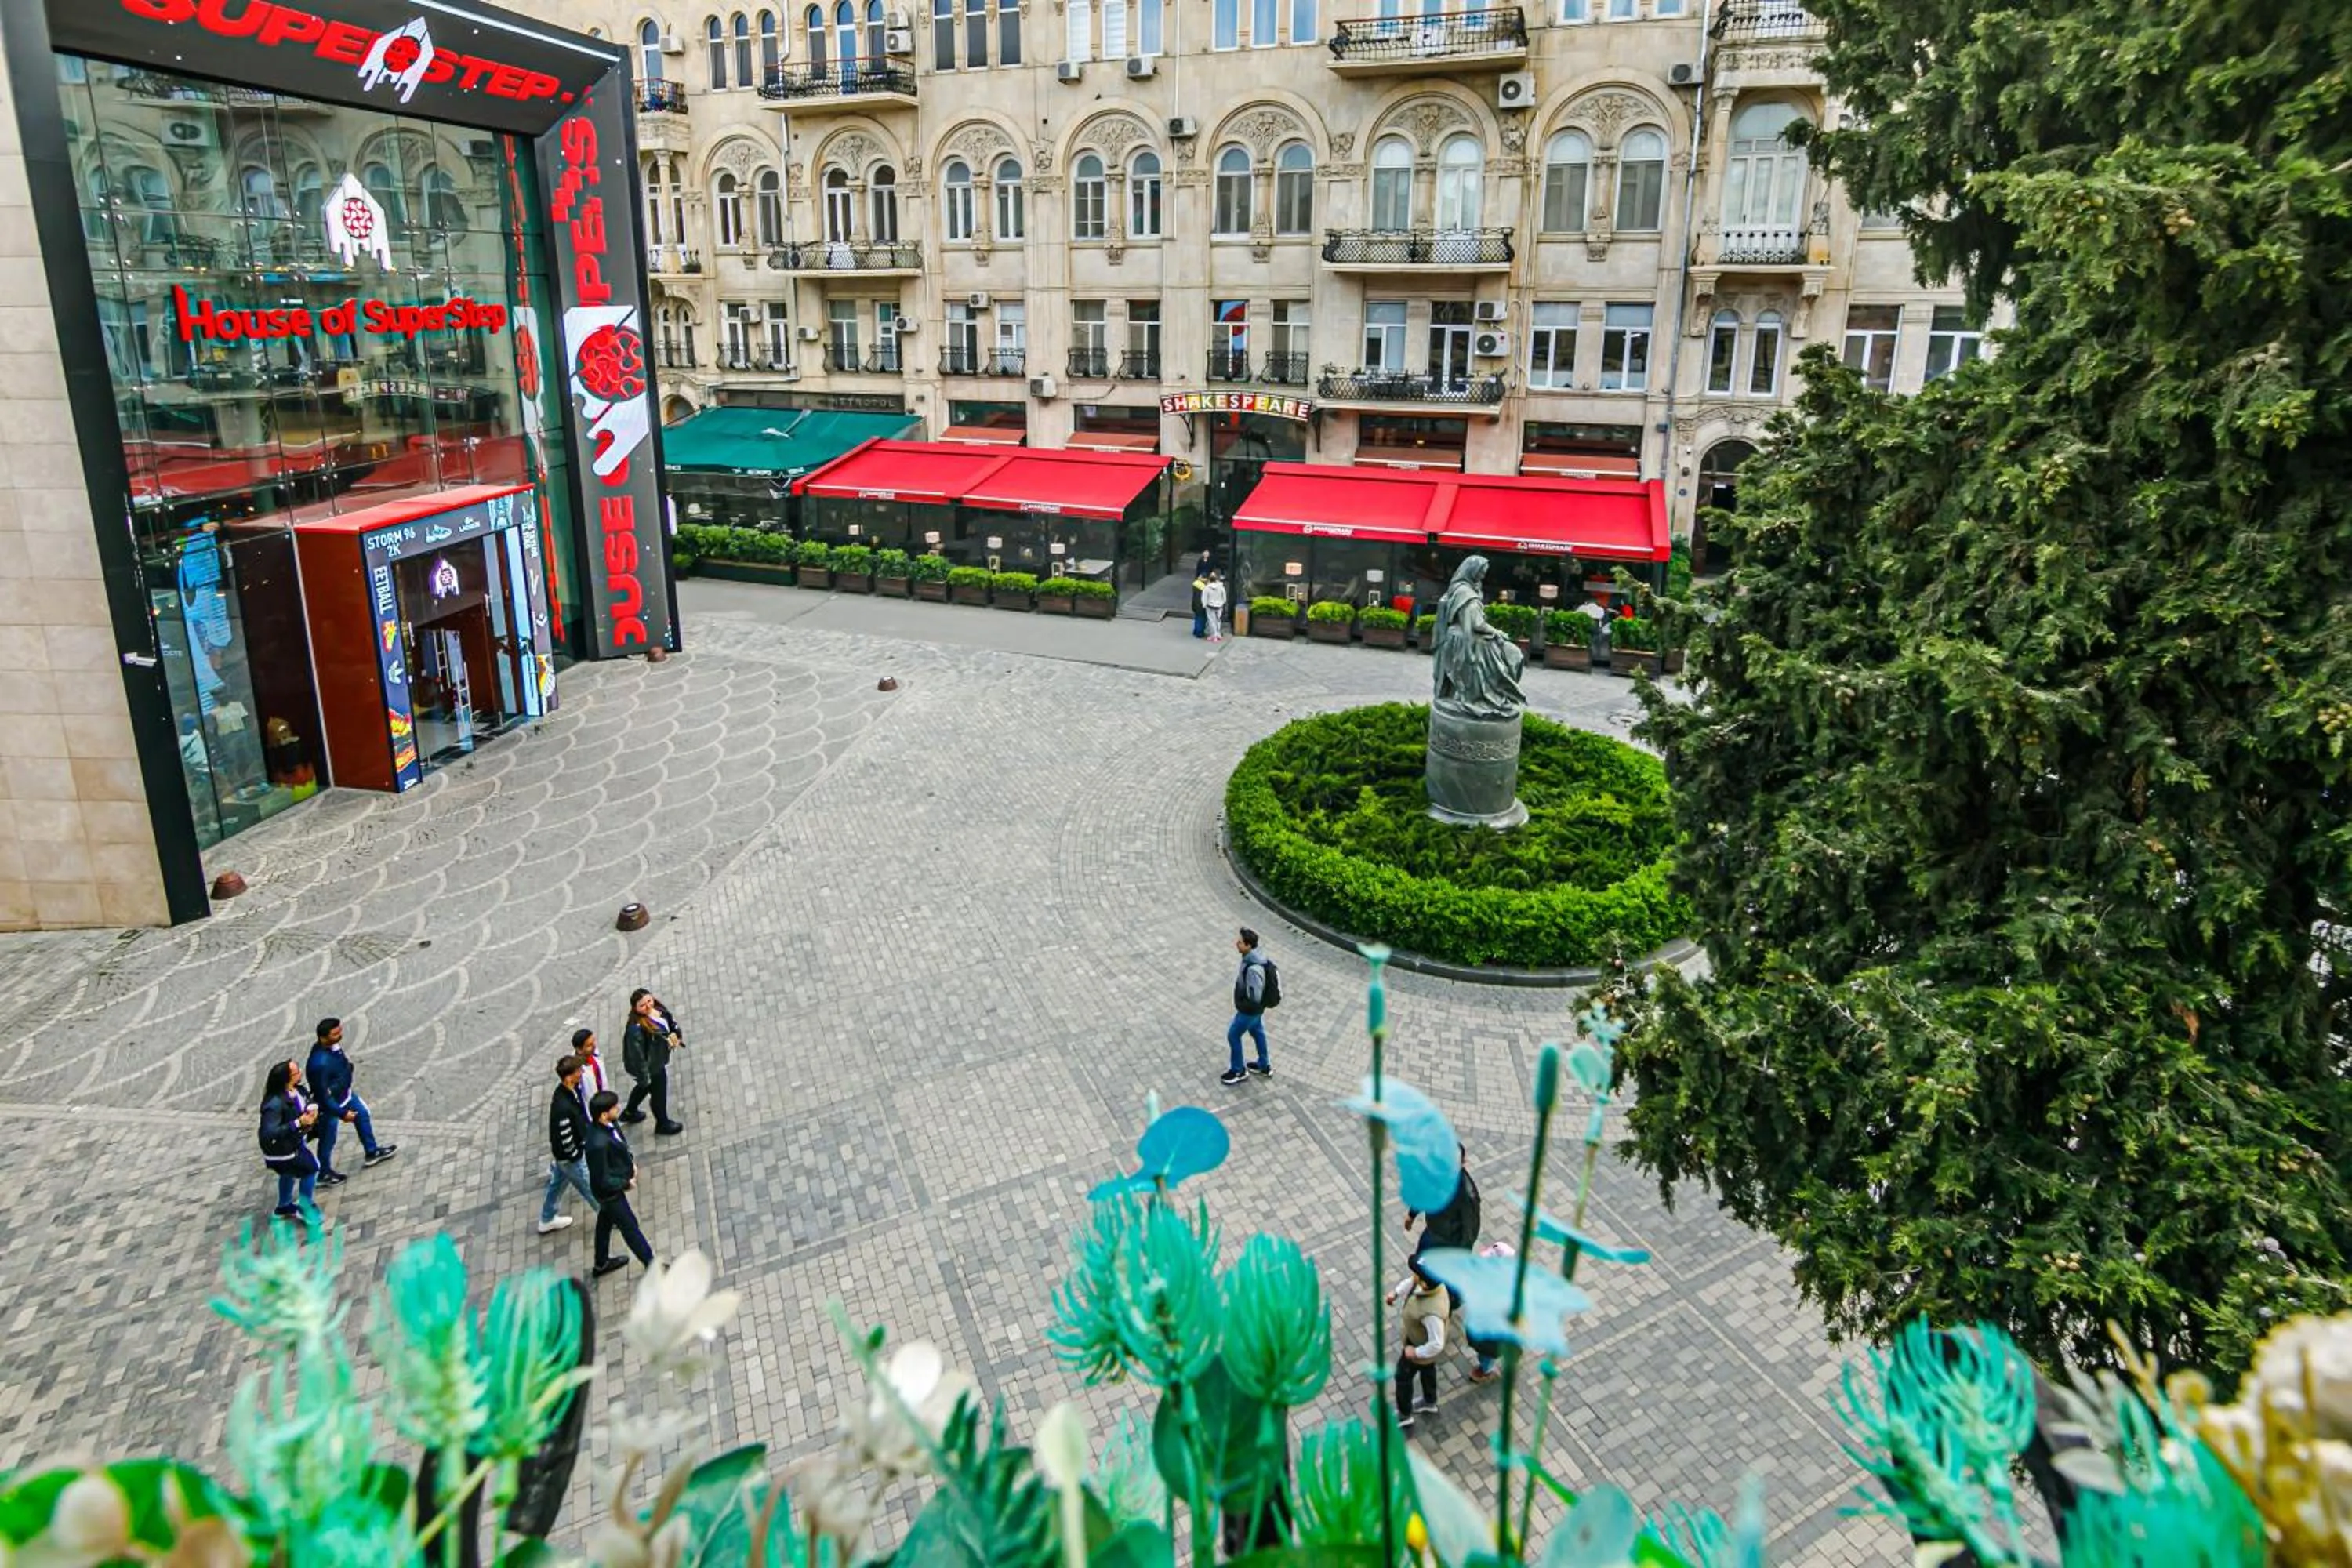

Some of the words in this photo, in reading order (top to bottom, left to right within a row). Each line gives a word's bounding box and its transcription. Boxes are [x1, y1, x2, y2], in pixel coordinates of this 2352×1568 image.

[171, 284, 312, 341] House
[320, 296, 358, 336] of
[363, 296, 507, 339] SuperStep
[1163, 394, 1310, 419] SHAKESPEARE
[367, 530, 402, 550] STORM
[403, 526, 416, 541] 96
[387, 544, 402, 558] 2K
